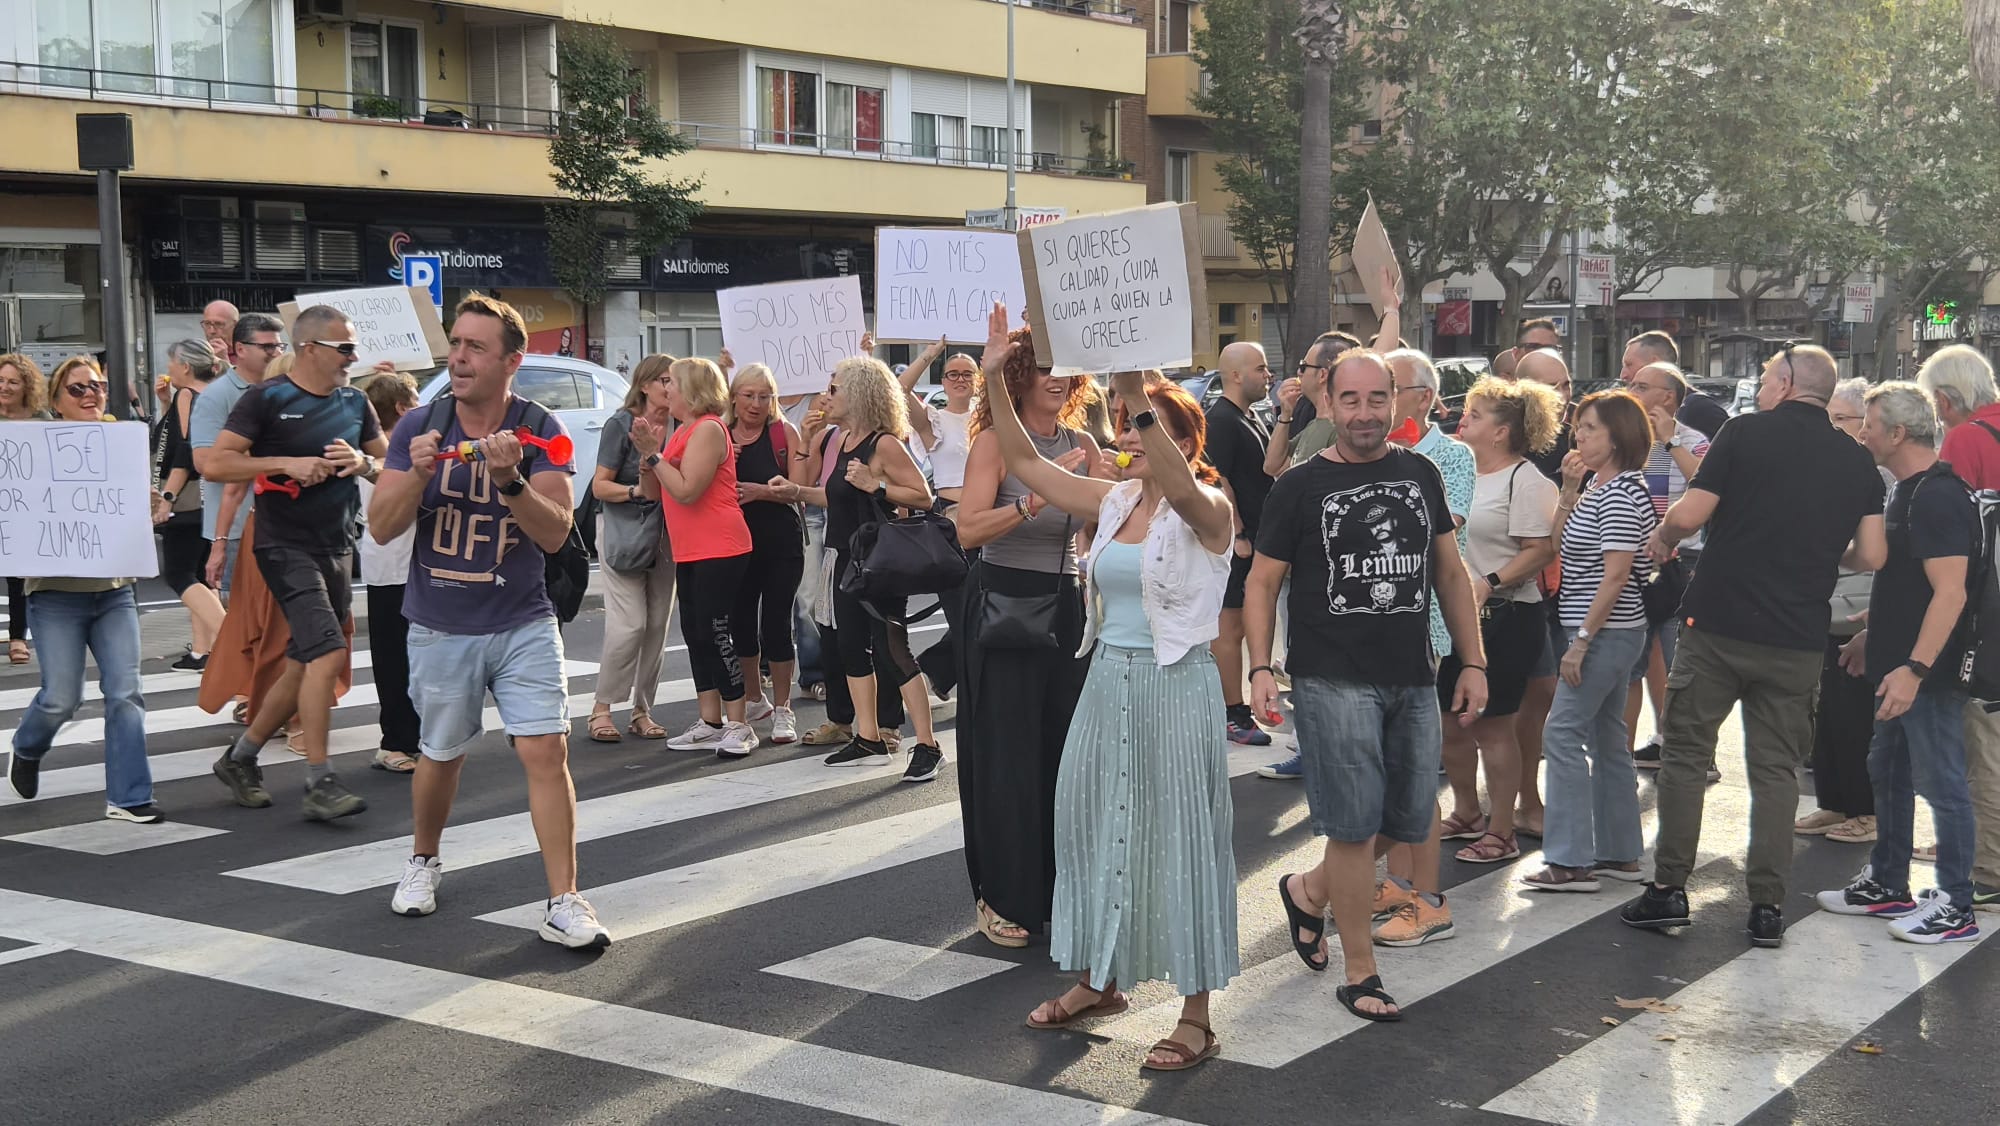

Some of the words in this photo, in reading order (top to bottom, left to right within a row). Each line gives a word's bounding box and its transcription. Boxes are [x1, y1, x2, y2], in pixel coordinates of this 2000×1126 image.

[1019, 212, 1061, 229] LaFA
[162, 240, 179, 250] SALT
[417, 248, 503, 268] Tidiomes
[896, 238, 928, 271] NO
[948, 235, 986, 273] MÉS
[1044, 239, 1058, 267] SI
[1067, 226, 1131, 268] QUIERES
[411, 261, 435, 288] P
[663, 257, 730, 274] SALTidiomes
[1123, 257, 1159, 284] CUIDA
[1579, 256, 1610, 273] LaFACT
[361, 297, 402, 316] CARDIO
[734, 294, 799, 332] SOUS
[809, 284, 848, 325] MÉS
[890, 286, 939, 321] FEINA
[946, 287, 958, 321] A
[1052, 299, 1087, 321] CUIDA
[1093, 296, 1101, 313] A
[1111, 289, 1150, 312] QUIEN
[1160, 286, 1173, 307] LA
[55, 430, 101, 474] 5€
[43, 487, 56, 513] 1
[72, 487, 126, 515] CLASE
[37, 520, 103, 559] ZUMBA
[432, 503, 519, 565] OFF
[1339, 552, 1421, 580] Lemmy
